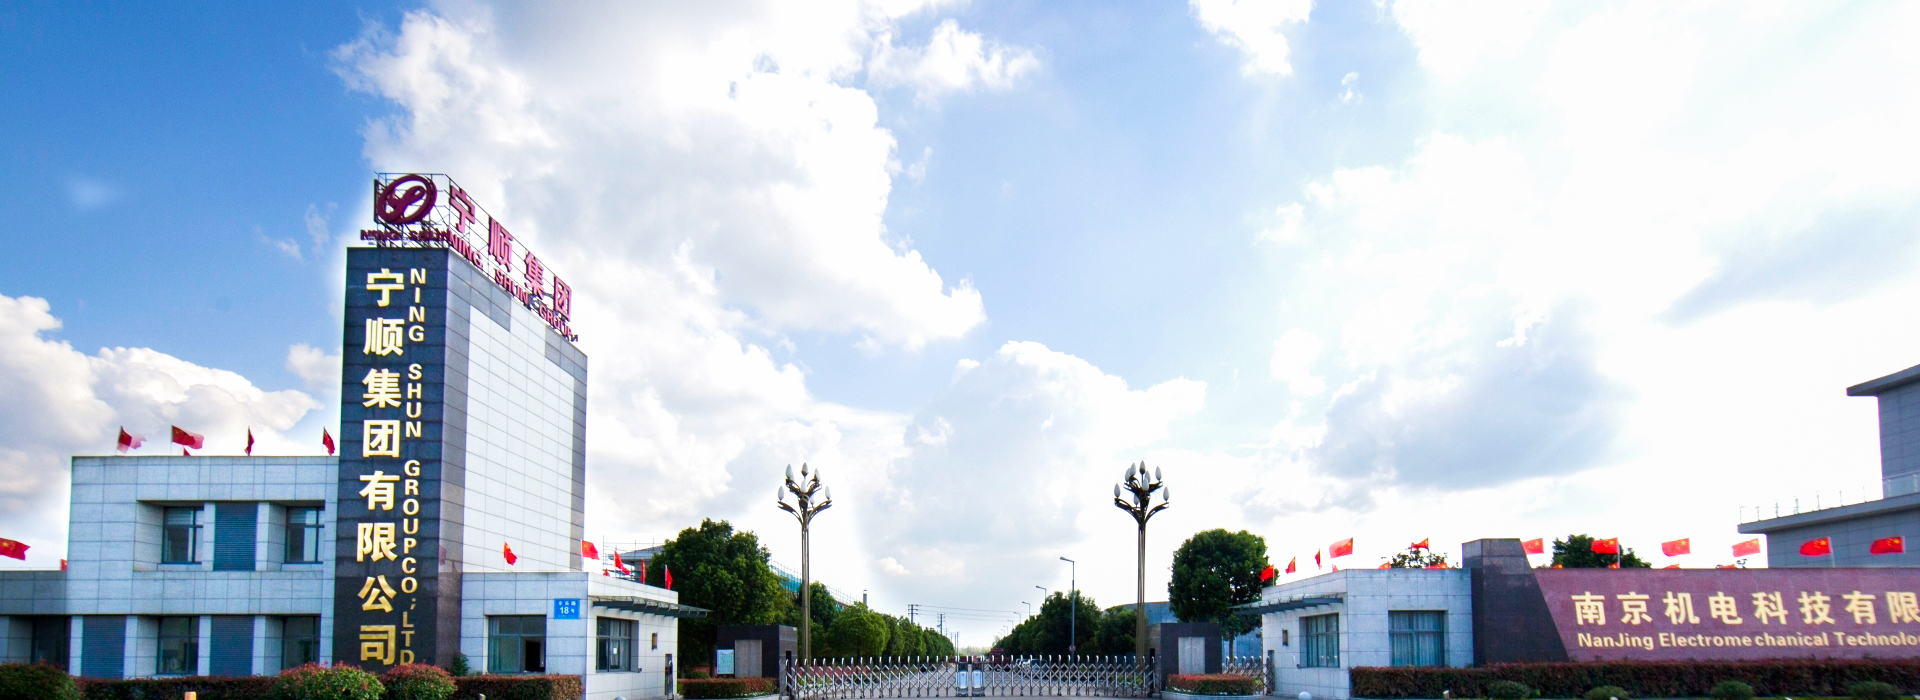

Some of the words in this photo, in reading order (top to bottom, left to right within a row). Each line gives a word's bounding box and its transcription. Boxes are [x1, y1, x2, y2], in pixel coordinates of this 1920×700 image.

[447, 228, 483, 269] NING
[494, 268, 529, 308] SHUN
[449, 184, 572, 322] 宁顺集团
[408, 268, 426, 342] NING
[405, 363, 422, 438] SHUN
[356, 268, 405, 666] 宁顺集团有限公司
[1571, 591, 1920, 626] 南京机电科技有限
[1577, 632, 1654, 650] NanJing
[1833, 631, 1920, 646] Technolo
